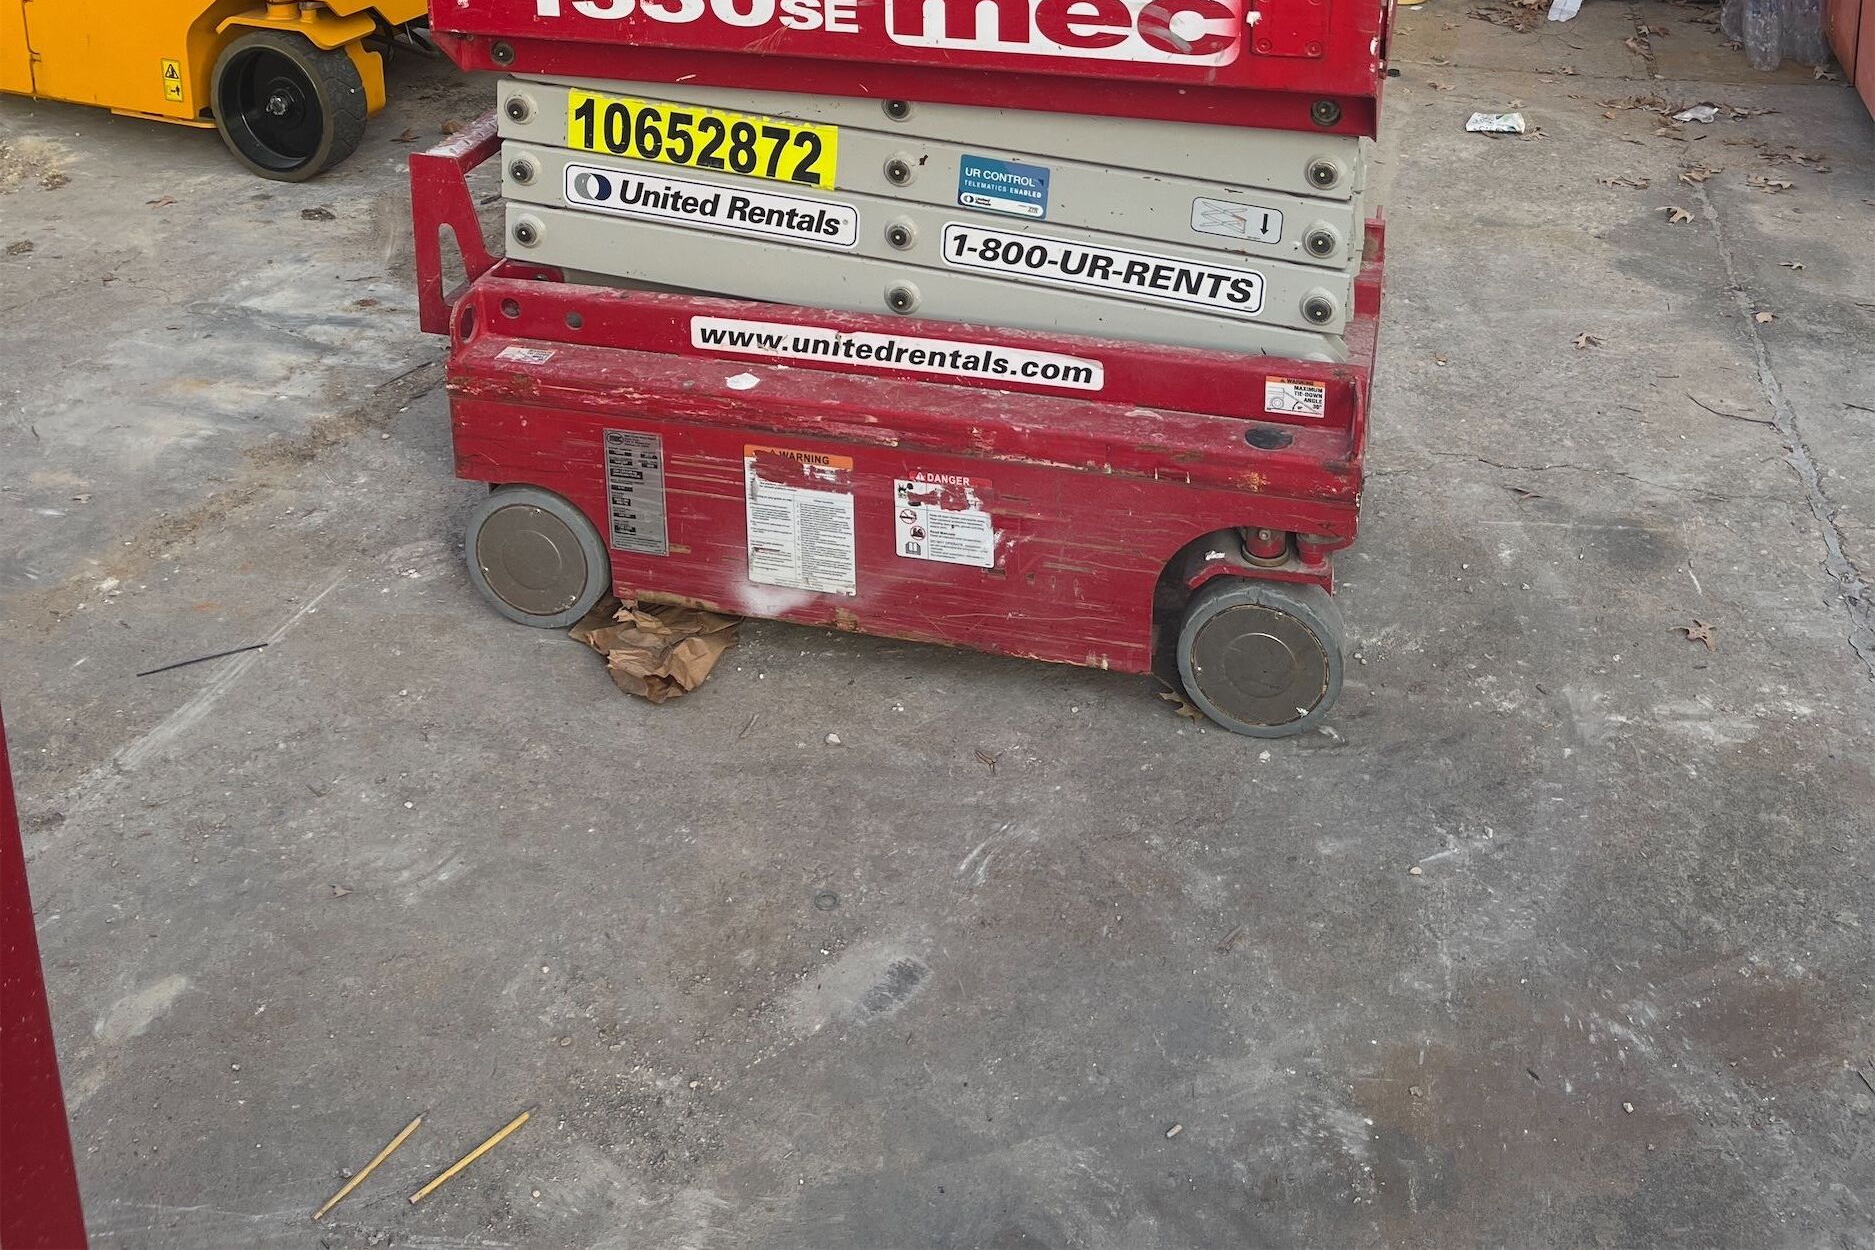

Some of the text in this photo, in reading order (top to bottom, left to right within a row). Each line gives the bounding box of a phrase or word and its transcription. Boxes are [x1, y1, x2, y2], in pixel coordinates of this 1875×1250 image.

[574, 97, 823, 185] 10652872
[965, 166, 1036, 188] UR CONTROL
[964, 179, 1042, 199] TELEMATICS ENABLED
[619, 180, 841, 236] United Rentals
[952, 233, 1254, 303] 1-800-UR-RENTS
[700, 327, 1093, 384] www.unitedrentals.com
[1293, 385, 1323, 393] MAXIMUM
[778, 450, 830, 465] WARNING
[927, 473, 970, 486] DANGER
